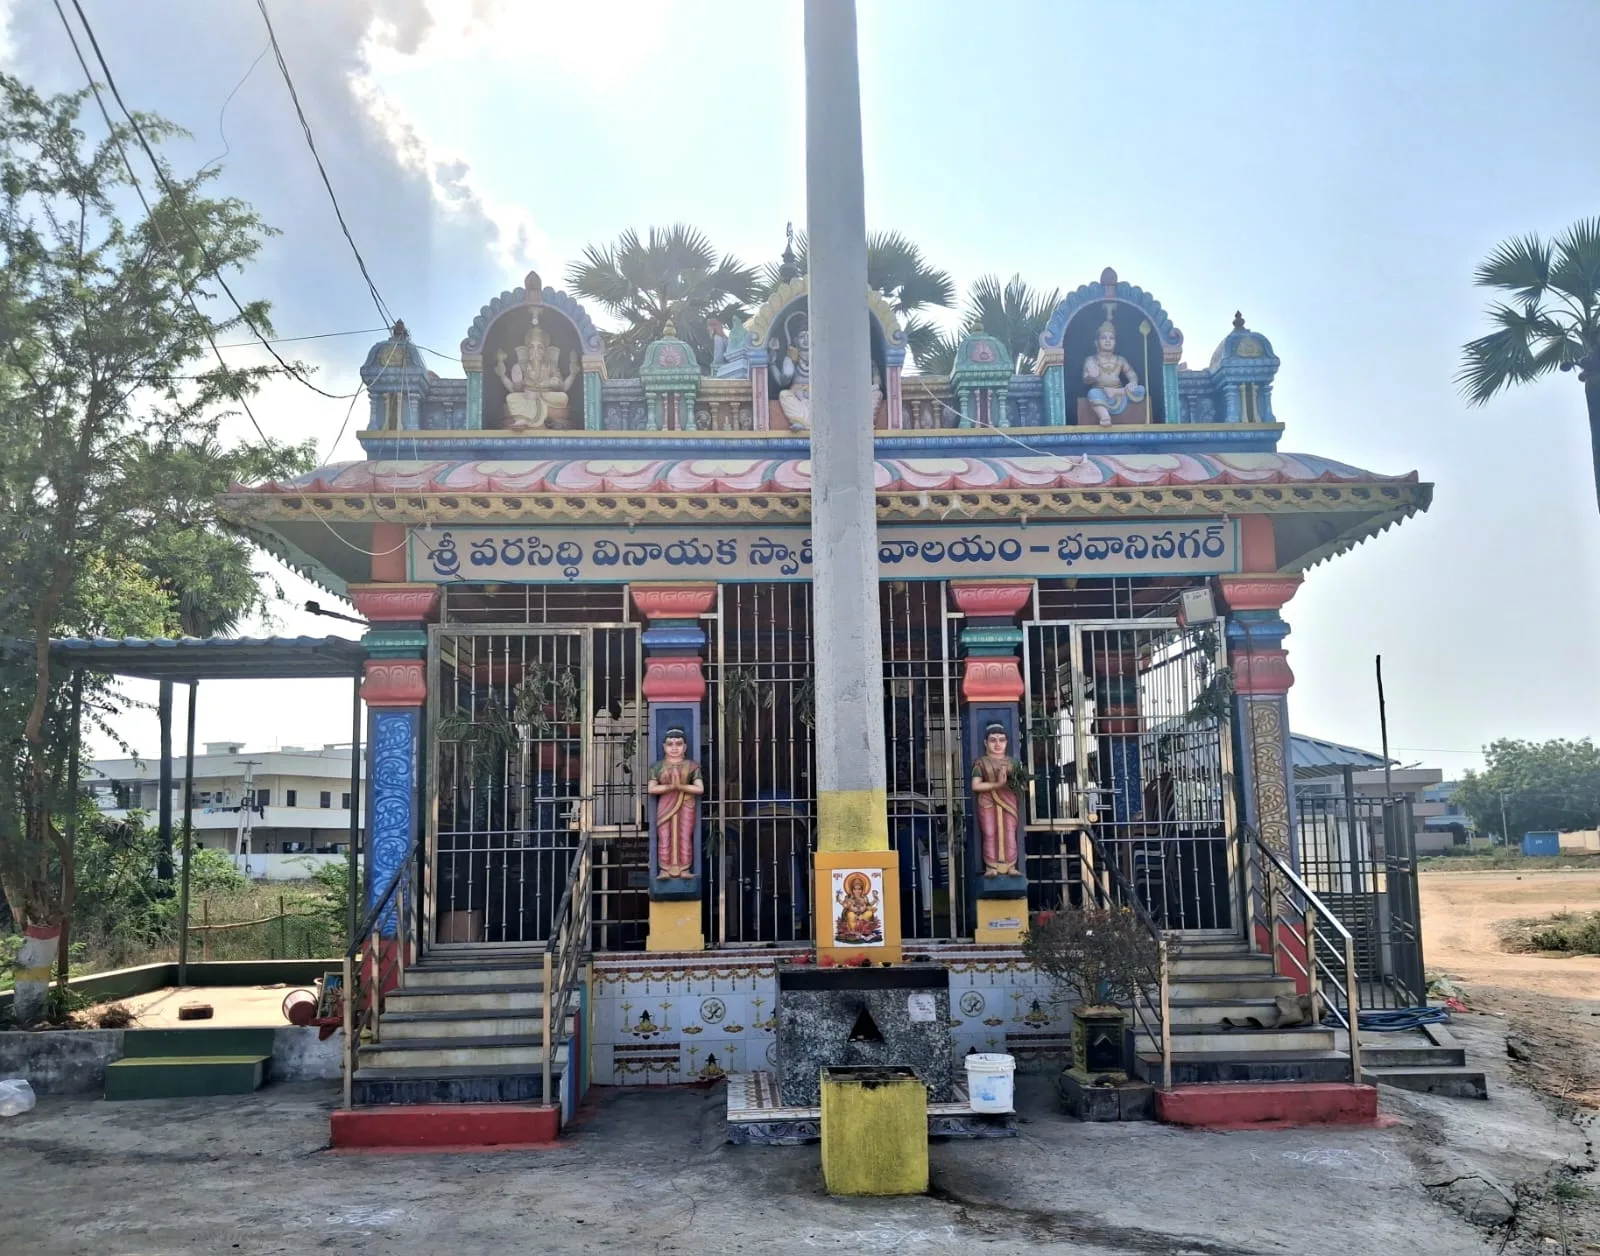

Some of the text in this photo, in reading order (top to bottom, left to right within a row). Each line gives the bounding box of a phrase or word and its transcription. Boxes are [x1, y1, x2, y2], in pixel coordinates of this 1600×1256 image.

[427, 532, 460, 575] శ్రీ
[470, 536, 583, 582] వరసిద్ధి
[592, 537, 737, 566] వినాయక
[878, 534, 1022, 563] వాలయం
[1057, 525, 1225, 567] భవానినగర్
